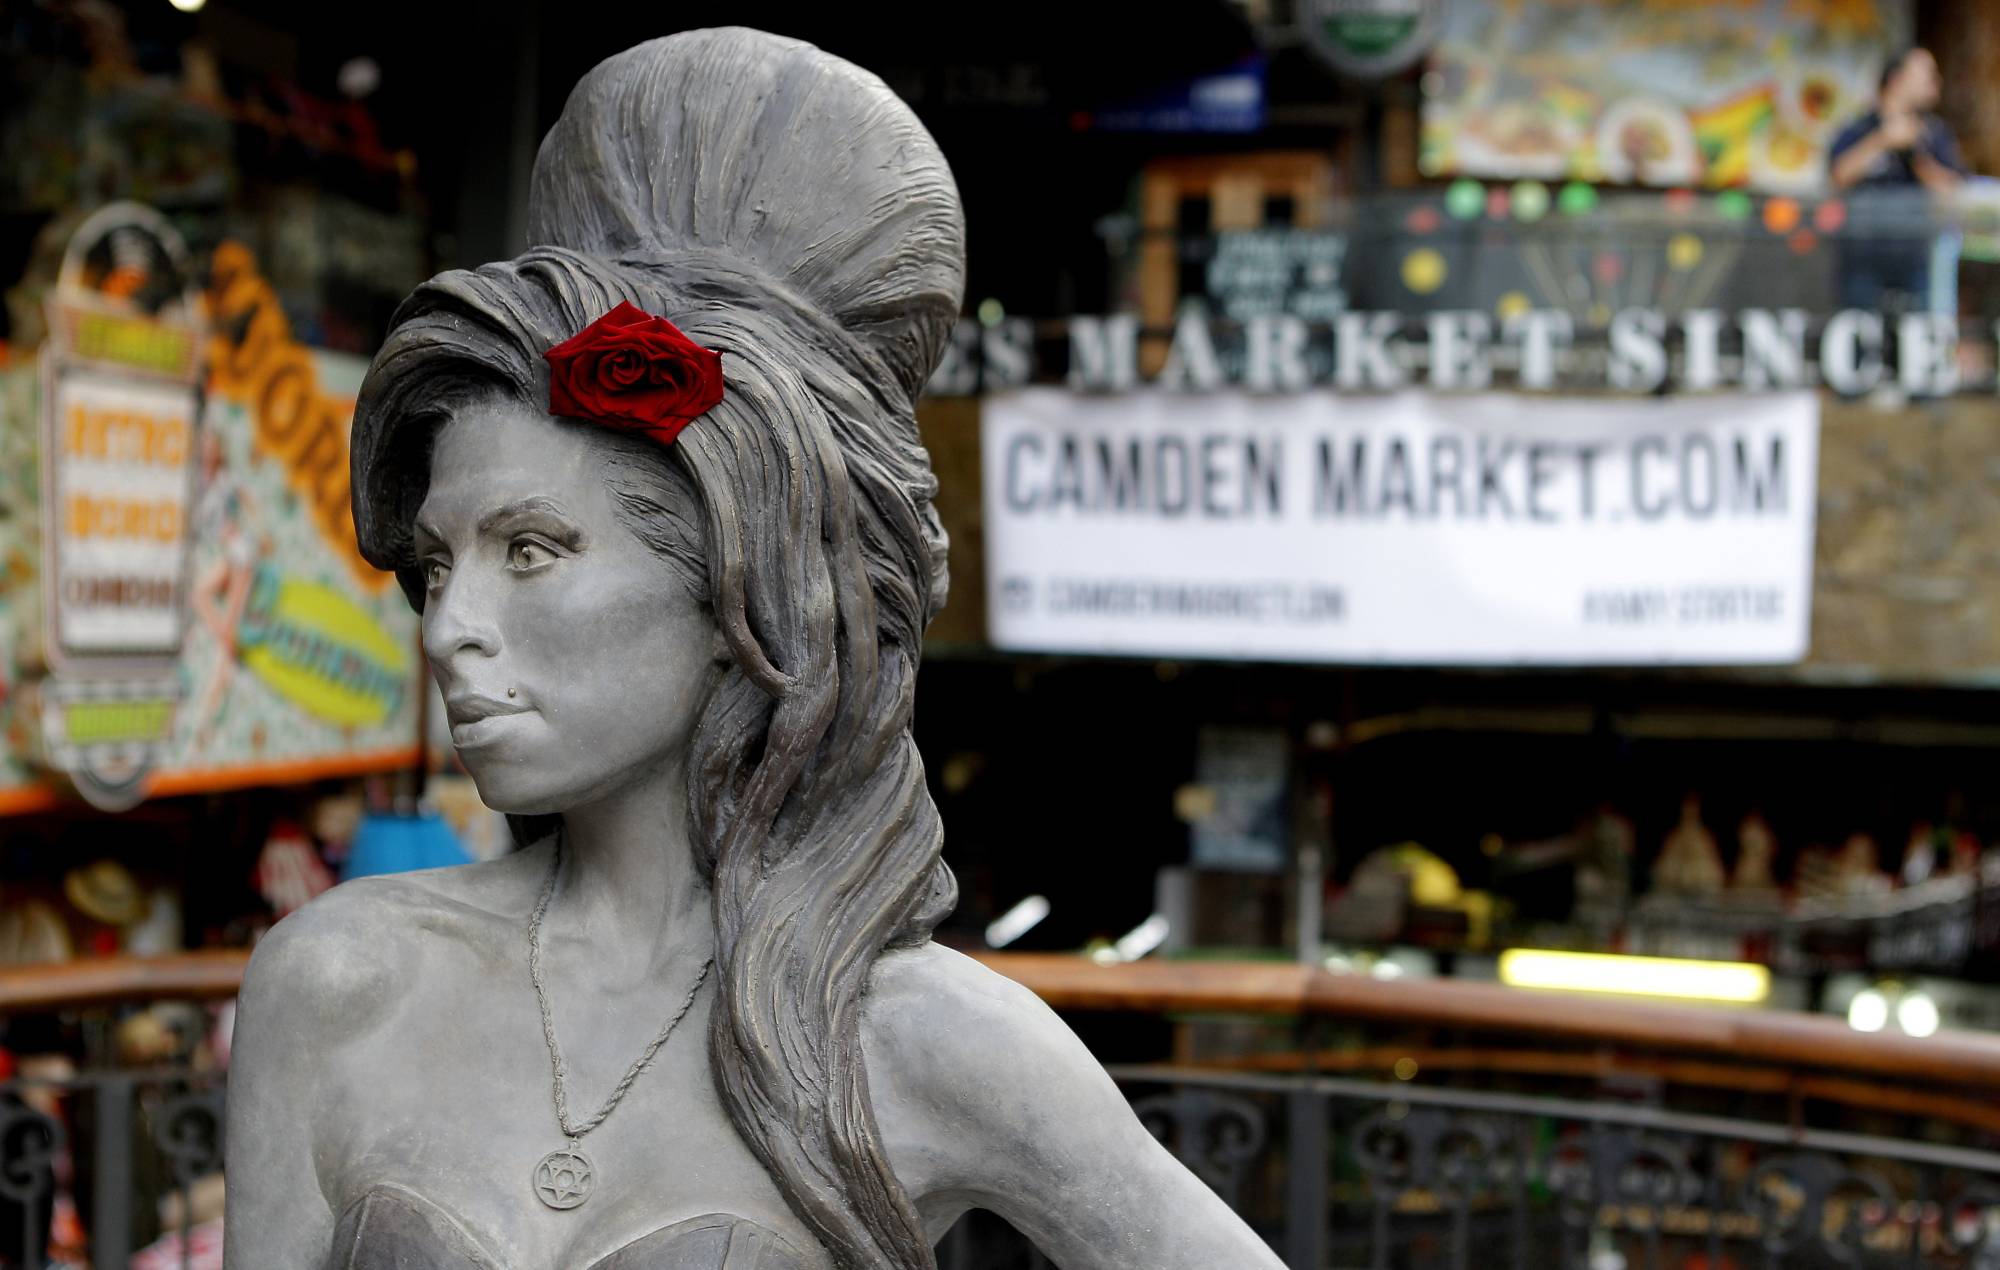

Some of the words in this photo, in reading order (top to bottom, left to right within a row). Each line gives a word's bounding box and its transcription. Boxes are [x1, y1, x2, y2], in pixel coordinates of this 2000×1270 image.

[1068, 304, 1574, 390] MARKET
[1608, 306, 1960, 397] SINCE
[1006, 430, 1283, 518] CAMDEN
[1313, 432, 1790, 524] MARKET.COM
